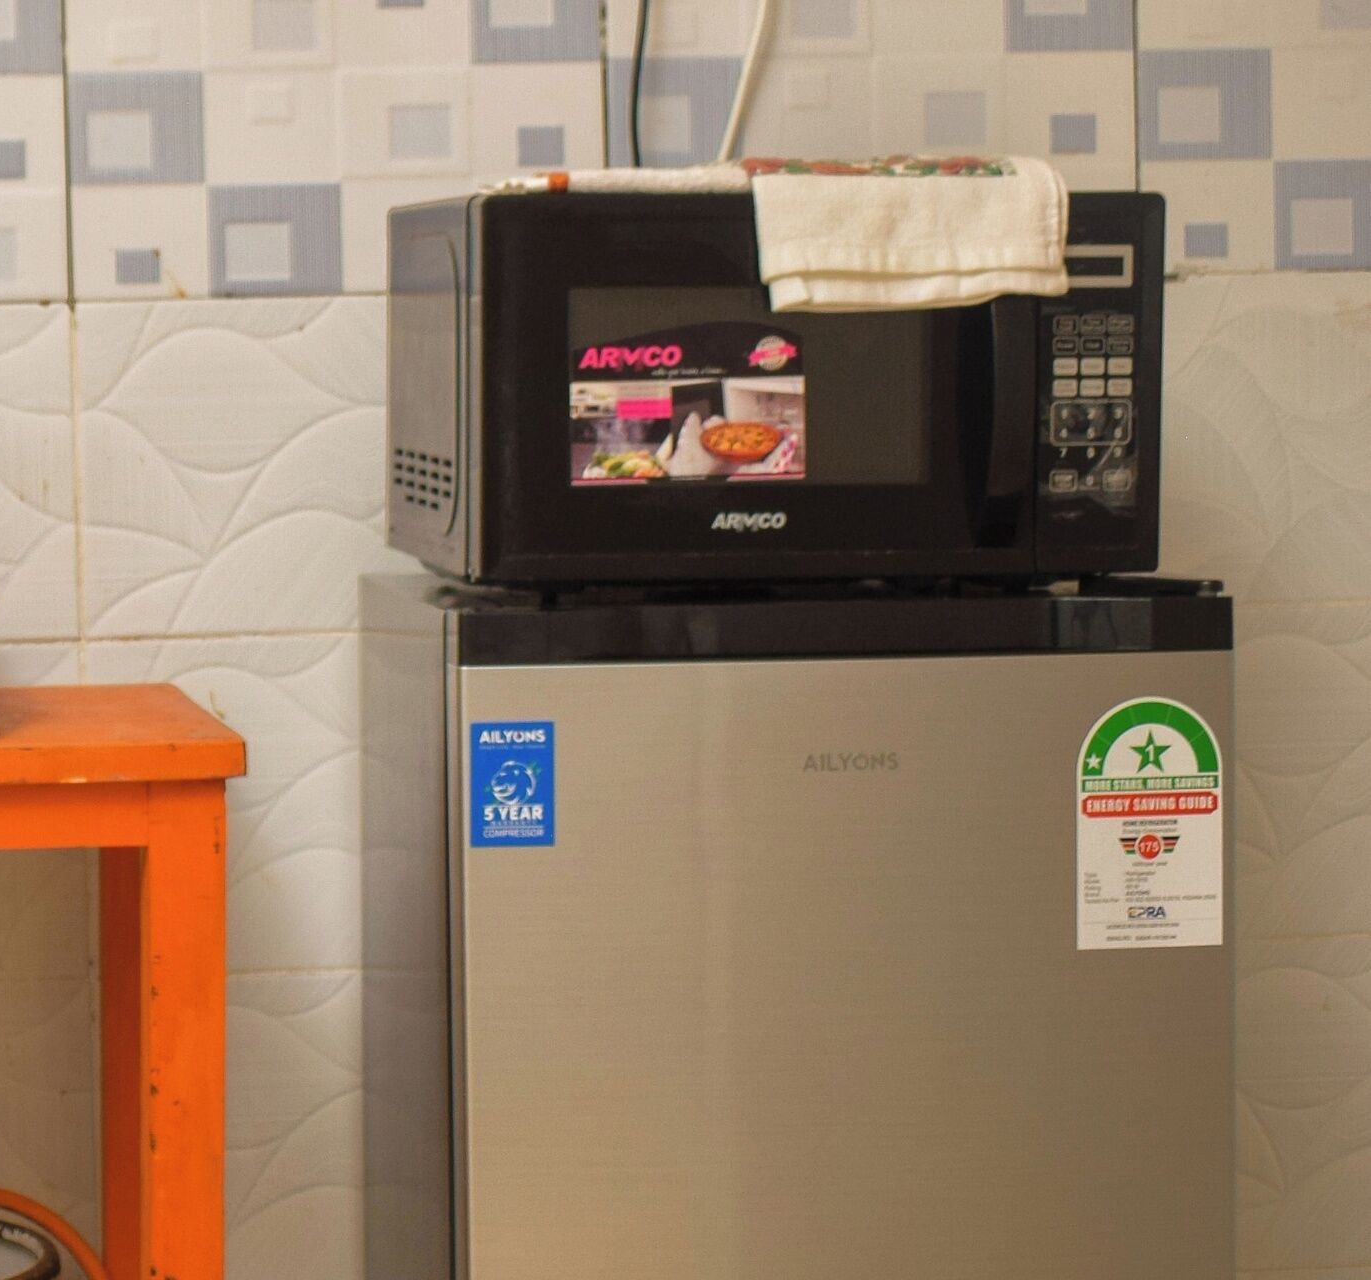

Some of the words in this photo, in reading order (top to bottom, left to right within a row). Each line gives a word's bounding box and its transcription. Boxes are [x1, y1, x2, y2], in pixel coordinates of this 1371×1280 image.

[579, 345, 683, 369] ARMCO
[711, 512, 786, 531] ARMCO
[479, 729, 546, 744] AILYONS
[803, 752, 899, 772] AILYONS
[1145, 745, 1155, 762] 1
[1084, 780, 1111, 792] MORE
[1146, 778, 1173, 790] MORE
[1174, 777, 1214, 789] SAVINGS
[1086, 798, 1131, 813] ENERGY
[1132, 797, 1175, 811] SAVING
[1178, 795, 1214, 810] GUIDE
[483, 807, 495, 821] 5
[498, 805, 544, 820] YEAR
[1138, 842, 1160, 853] 175
